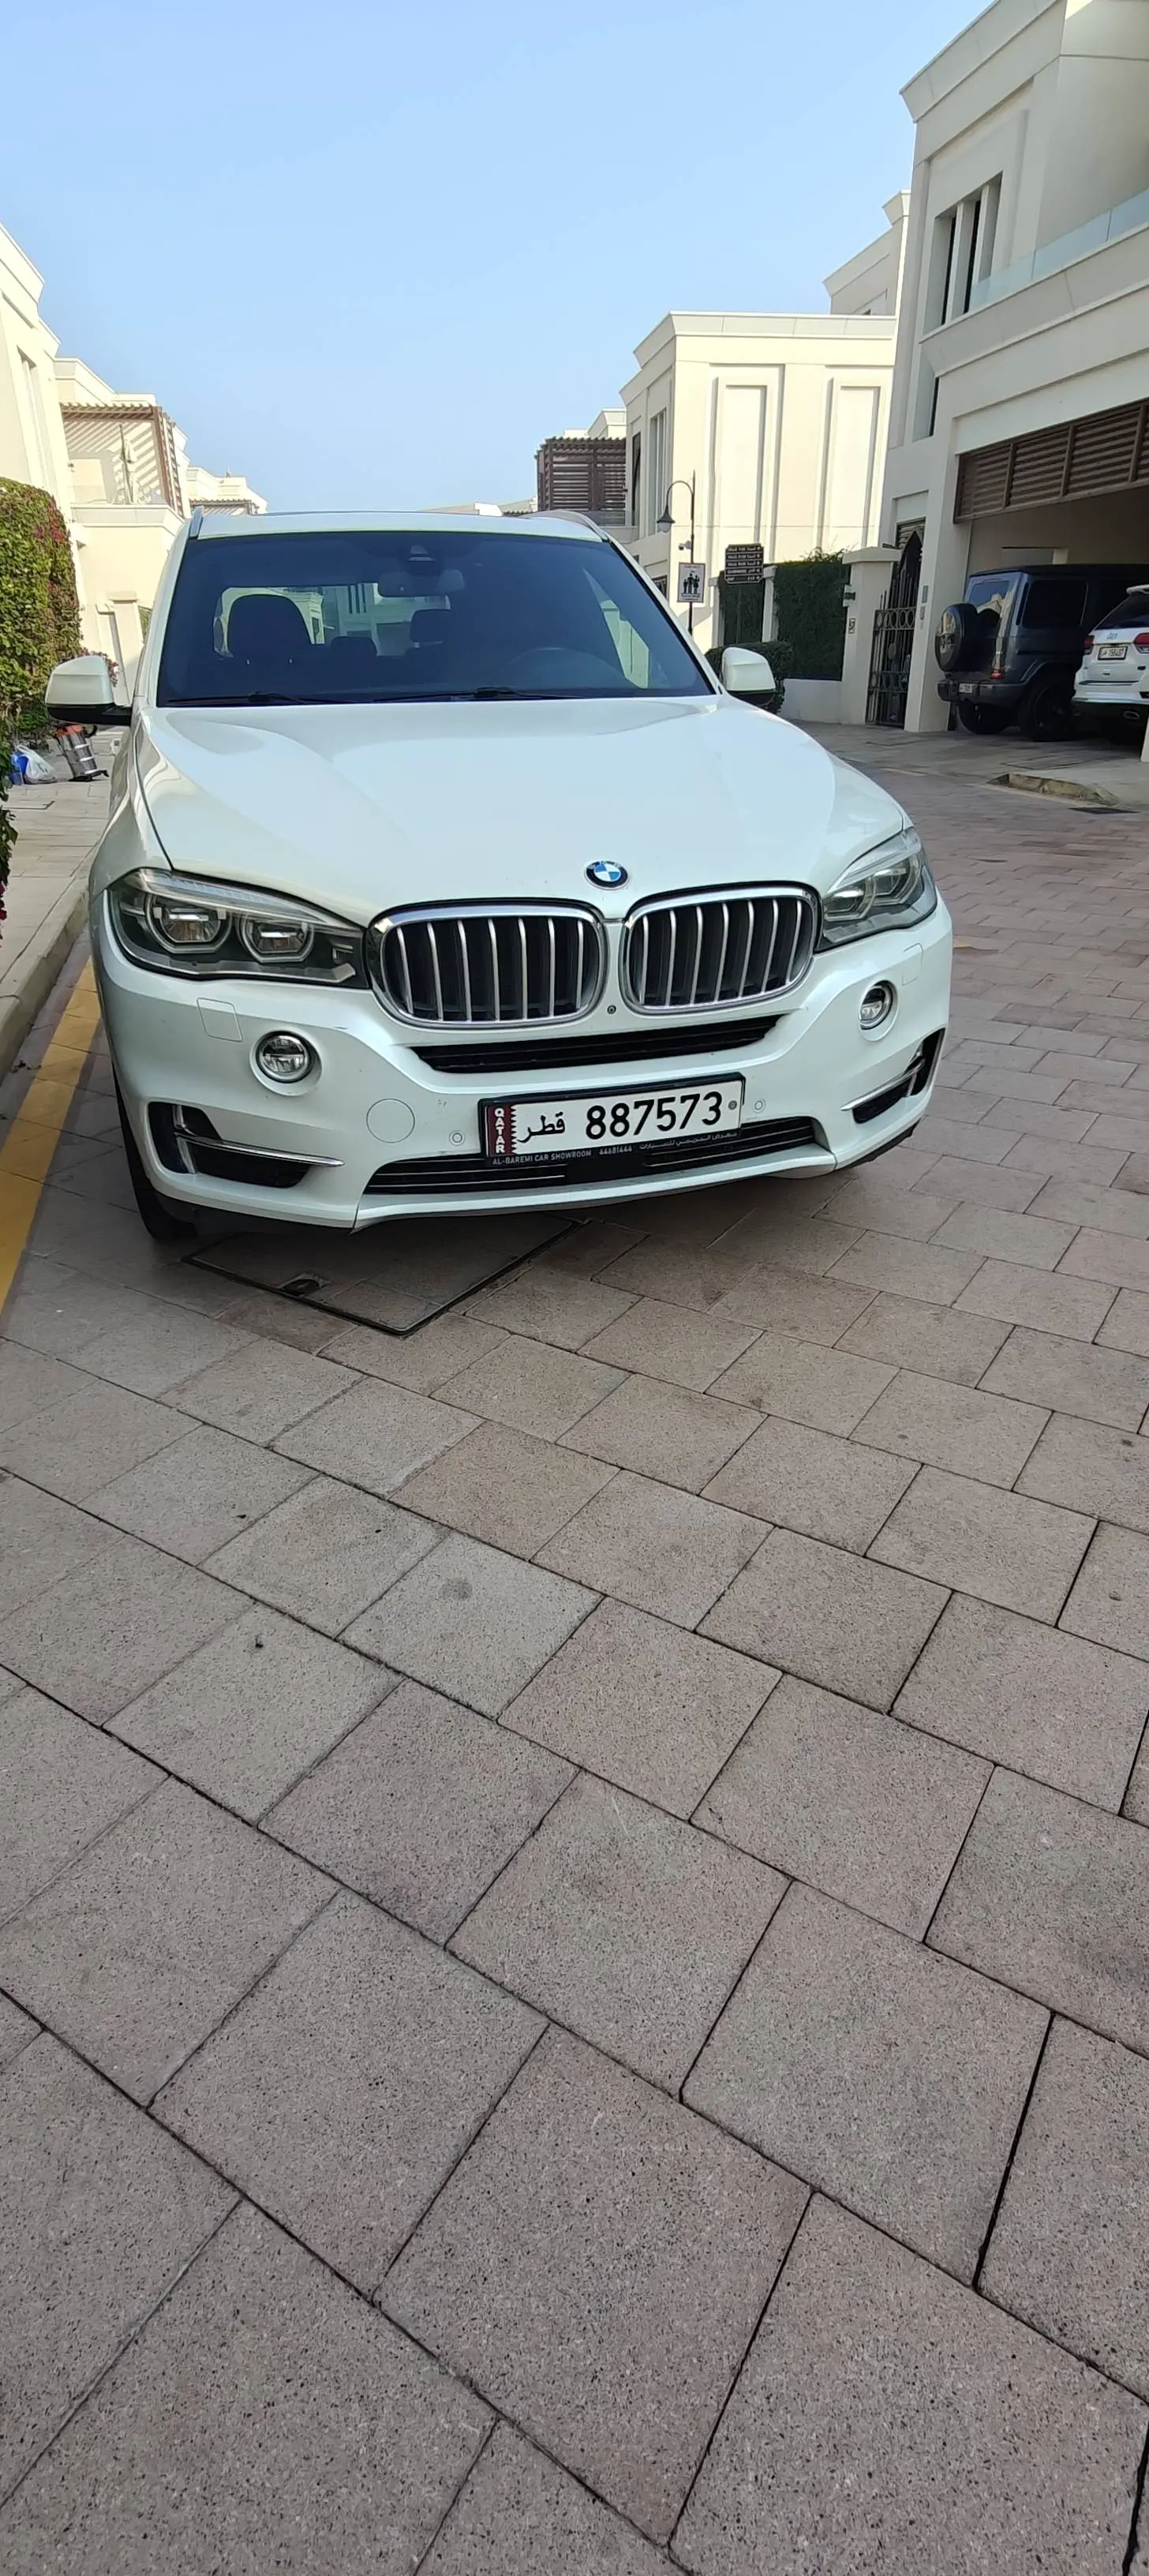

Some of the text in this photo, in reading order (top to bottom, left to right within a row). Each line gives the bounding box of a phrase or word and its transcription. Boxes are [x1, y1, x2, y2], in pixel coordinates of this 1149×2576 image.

[494, 1107, 506, 1154] QATAR
[517, 1111, 565, 1144] قطر
[586, 1091, 723, 1140] 887573
[551, 1150, 592, 1160] SHOWROOM
